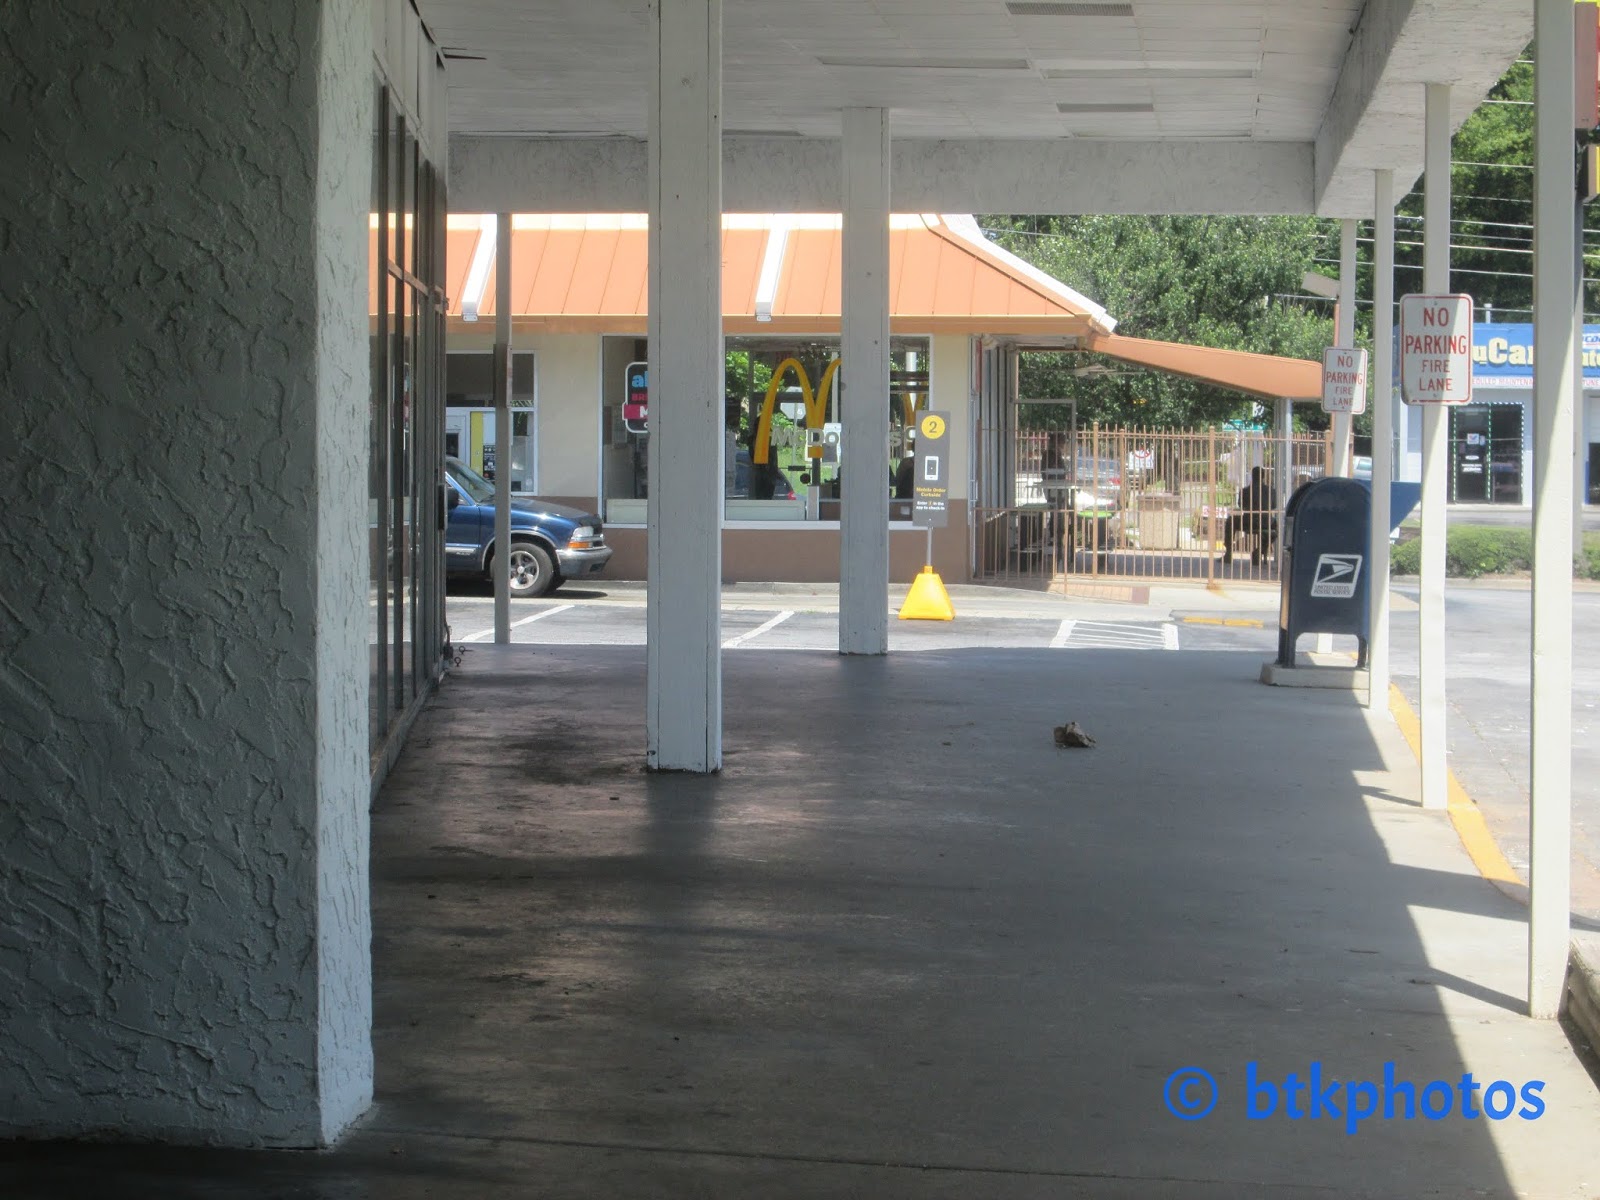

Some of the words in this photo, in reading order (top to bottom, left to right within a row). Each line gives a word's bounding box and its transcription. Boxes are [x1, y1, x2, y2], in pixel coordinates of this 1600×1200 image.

[1424, 307, 1449, 327] NO
[1405, 335, 1467, 355] PARKING
[1337, 356, 1353, 368] NO
[1422, 360, 1450, 373] FIRE
[1326, 371, 1363, 384] PARKING
[1335, 386, 1353, 396] FIRE
[1419, 378, 1453, 391] LANE
[1333, 397, 1353, 406] LANE
[928, 420, 938, 433] 2
